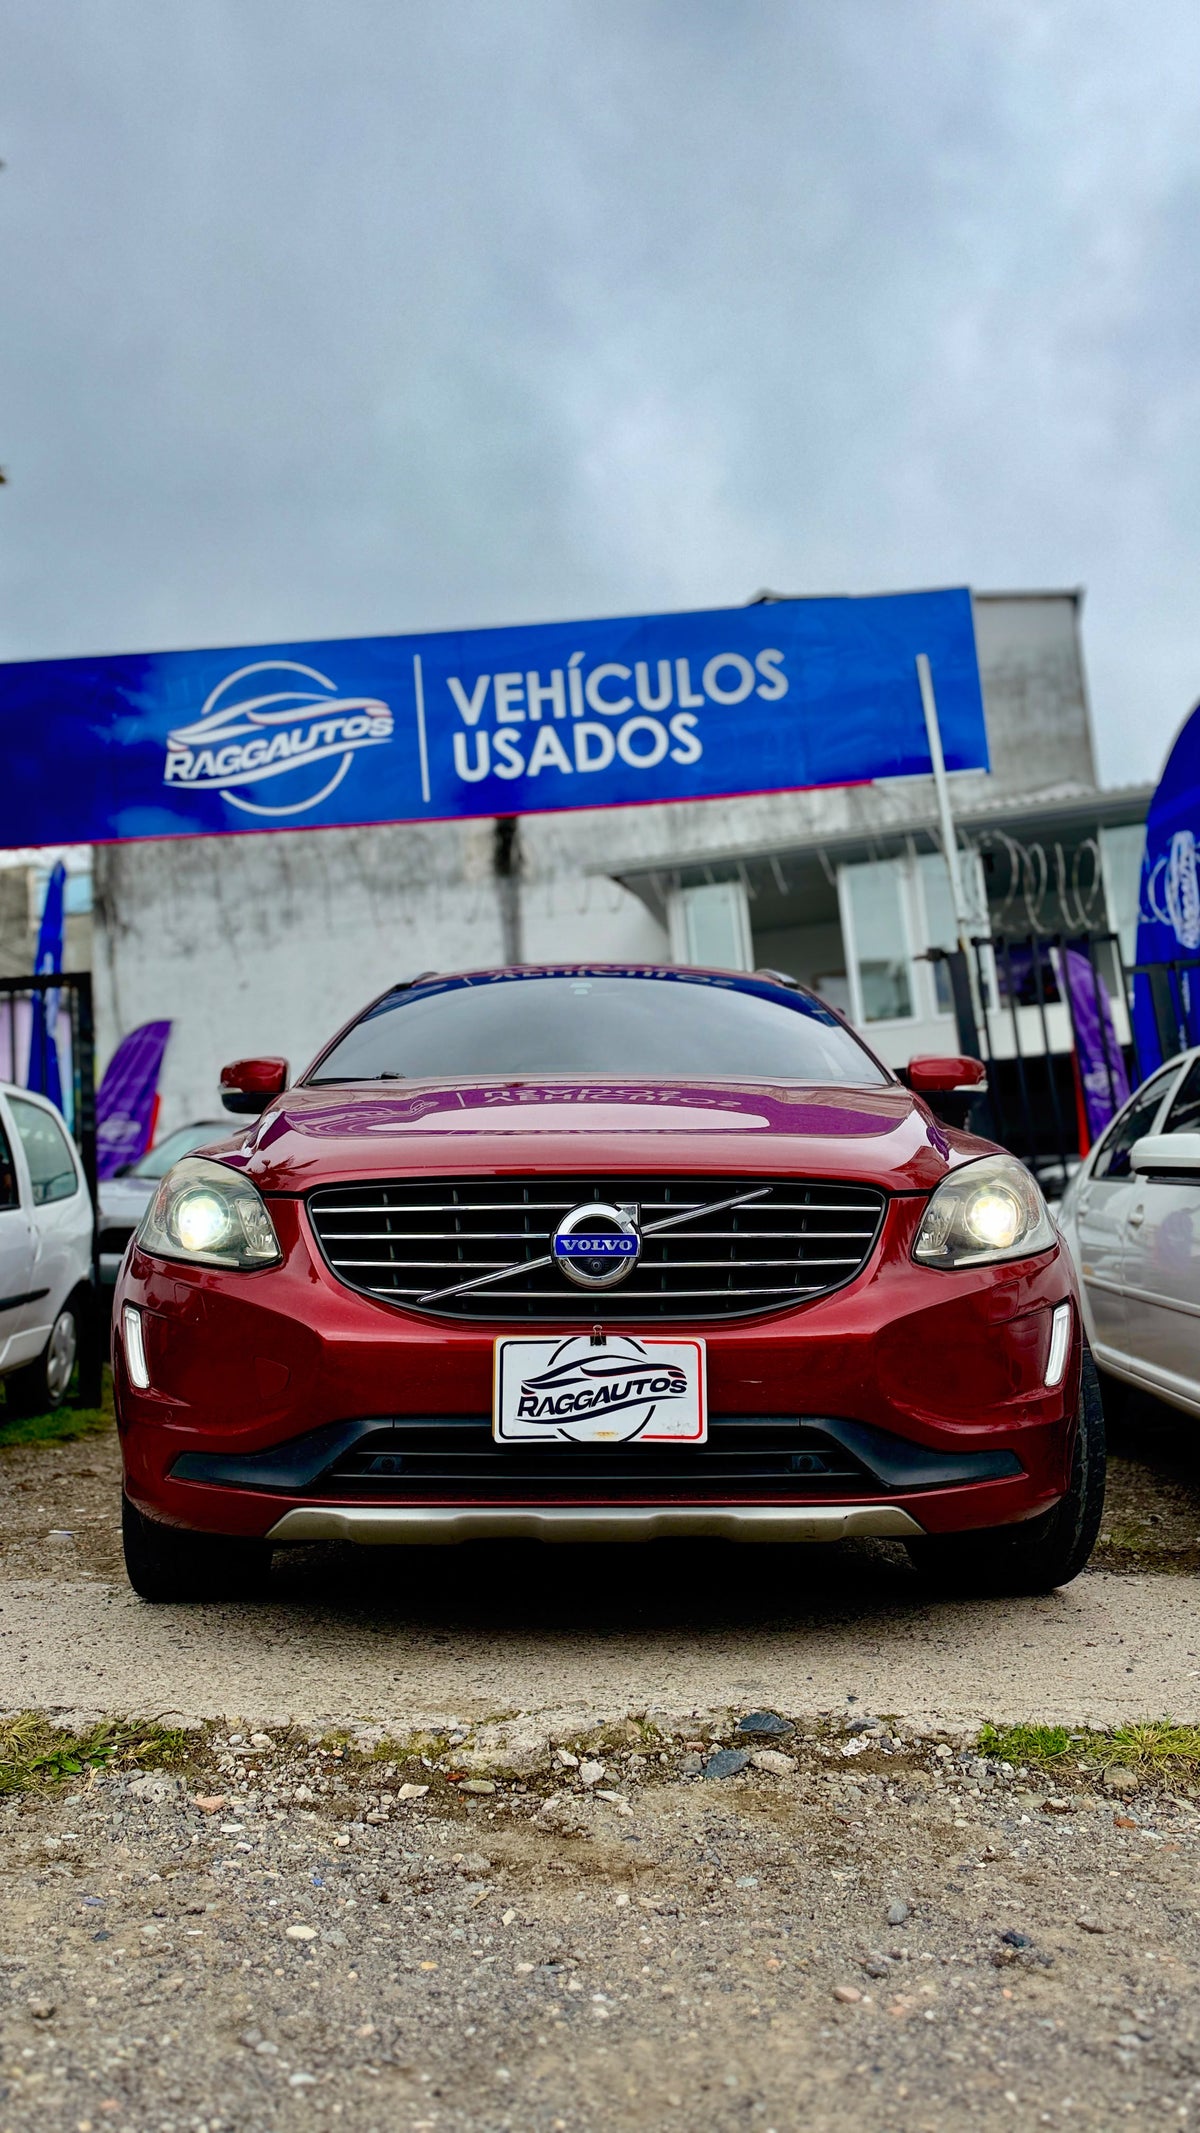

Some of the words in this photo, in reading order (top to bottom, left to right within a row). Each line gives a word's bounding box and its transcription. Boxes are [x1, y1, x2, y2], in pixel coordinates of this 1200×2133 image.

[447, 648, 790, 727] VEHÍCULOS
[164, 715, 395, 782] RAGGAUTOS
[453, 703, 704, 783] USADOS
[560, 1239, 633, 1251] VOLVO
[517, 1376, 688, 1418] RAGGAUTOS
